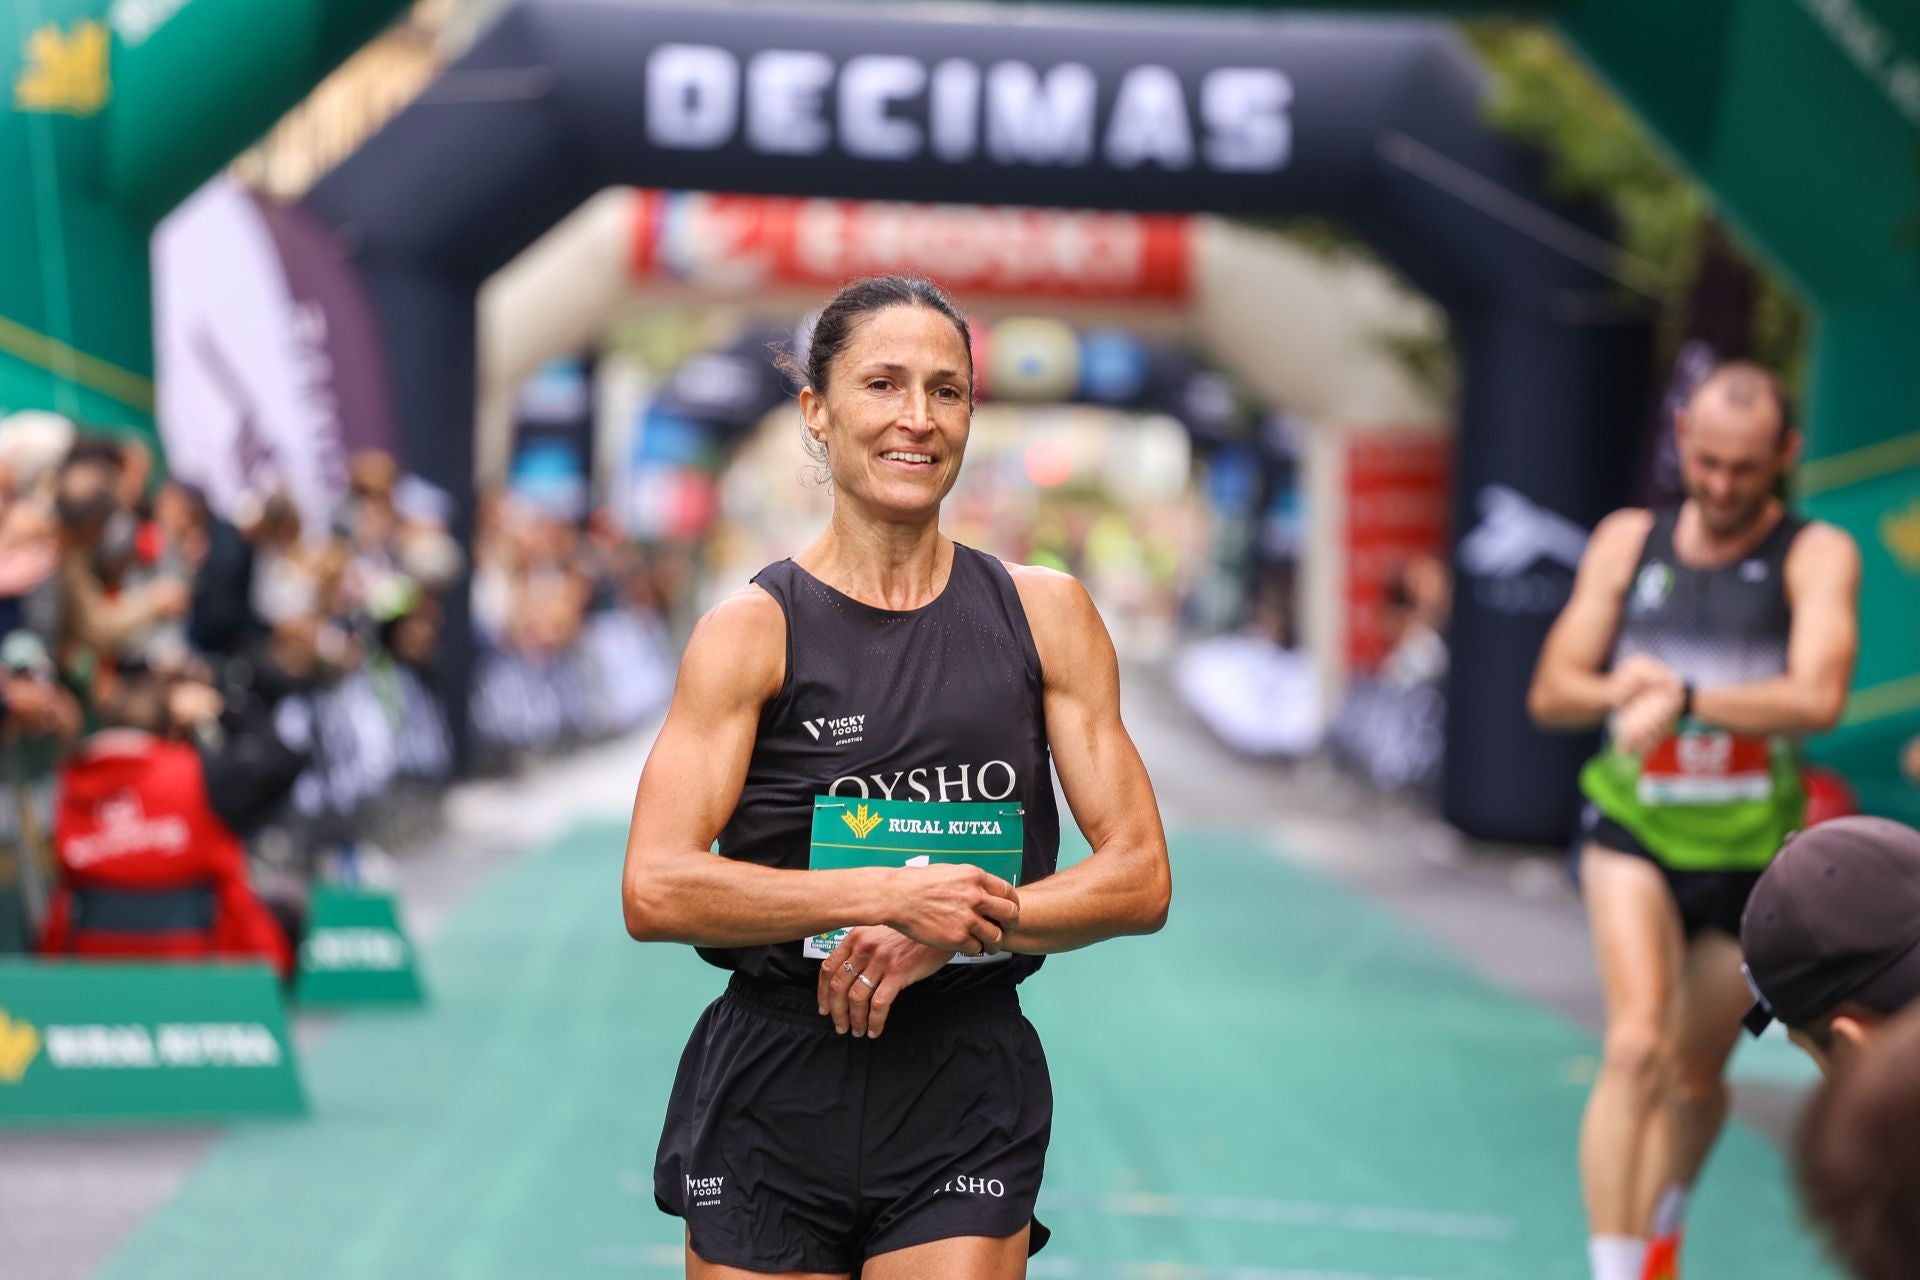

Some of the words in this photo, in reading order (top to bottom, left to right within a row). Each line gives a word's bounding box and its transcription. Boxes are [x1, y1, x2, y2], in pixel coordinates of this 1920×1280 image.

[645, 43, 1293, 173] DECIMAS
[828, 714, 865, 729] VICKY
[832, 724, 863, 737] FOODS
[889, 818, 944, 834] RURAL
[948, 821, 1002, 835] KUTXA
[689, 1176, 724, 1189] VICKY
[693, 1187, 722, 1197] FOODS
